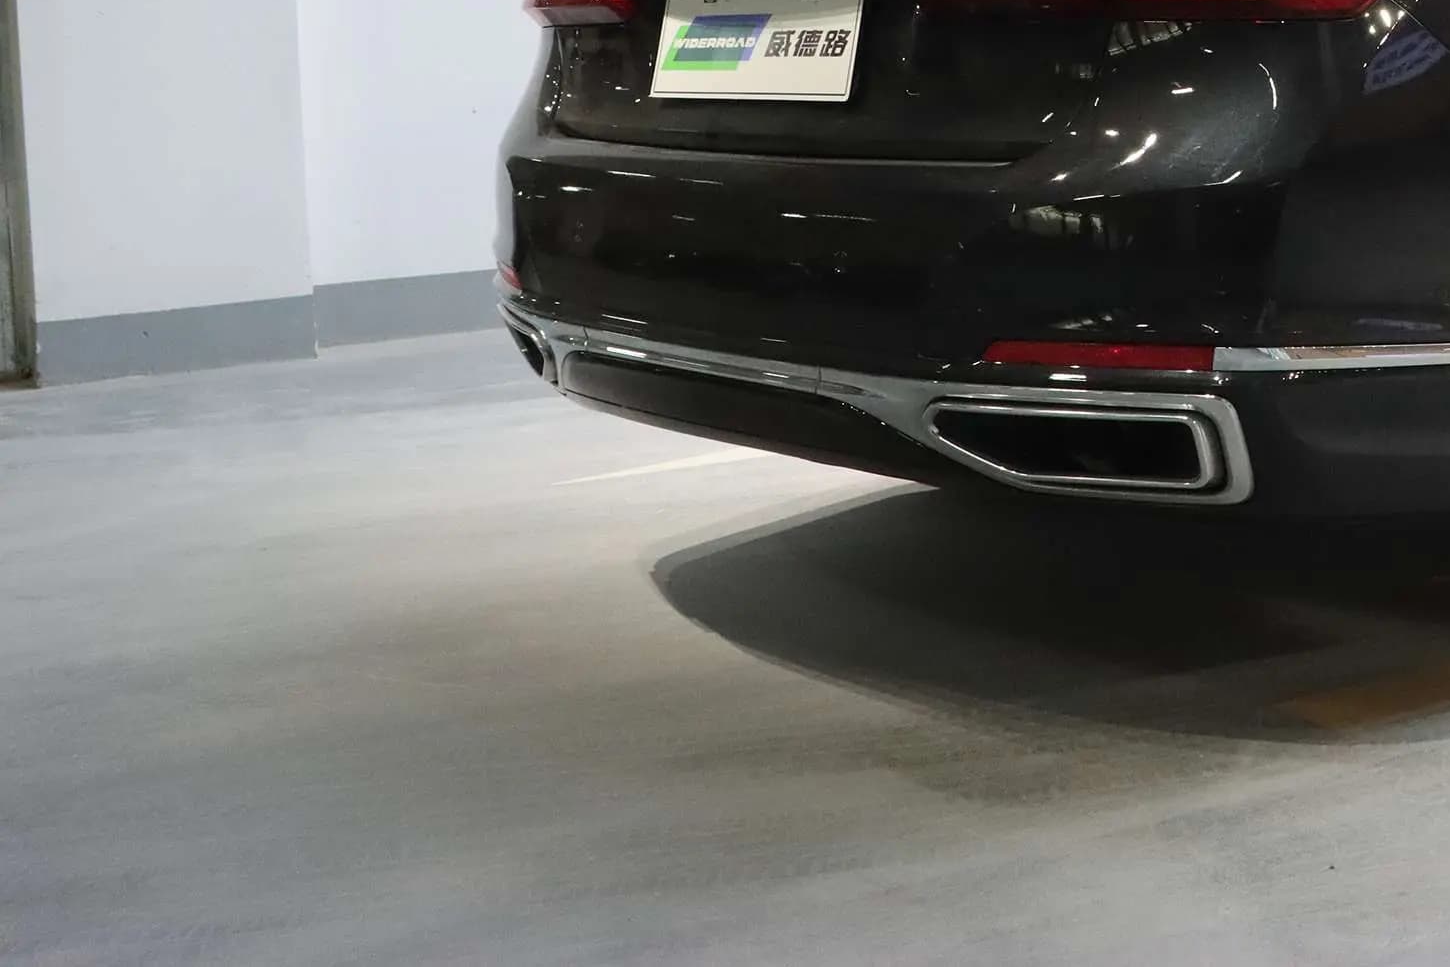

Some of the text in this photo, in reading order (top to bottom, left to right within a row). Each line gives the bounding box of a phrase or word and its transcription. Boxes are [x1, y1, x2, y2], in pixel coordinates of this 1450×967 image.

[674, 37, 756, 49] WIDERROAD
[764, 29, 852, 57] 威德路
